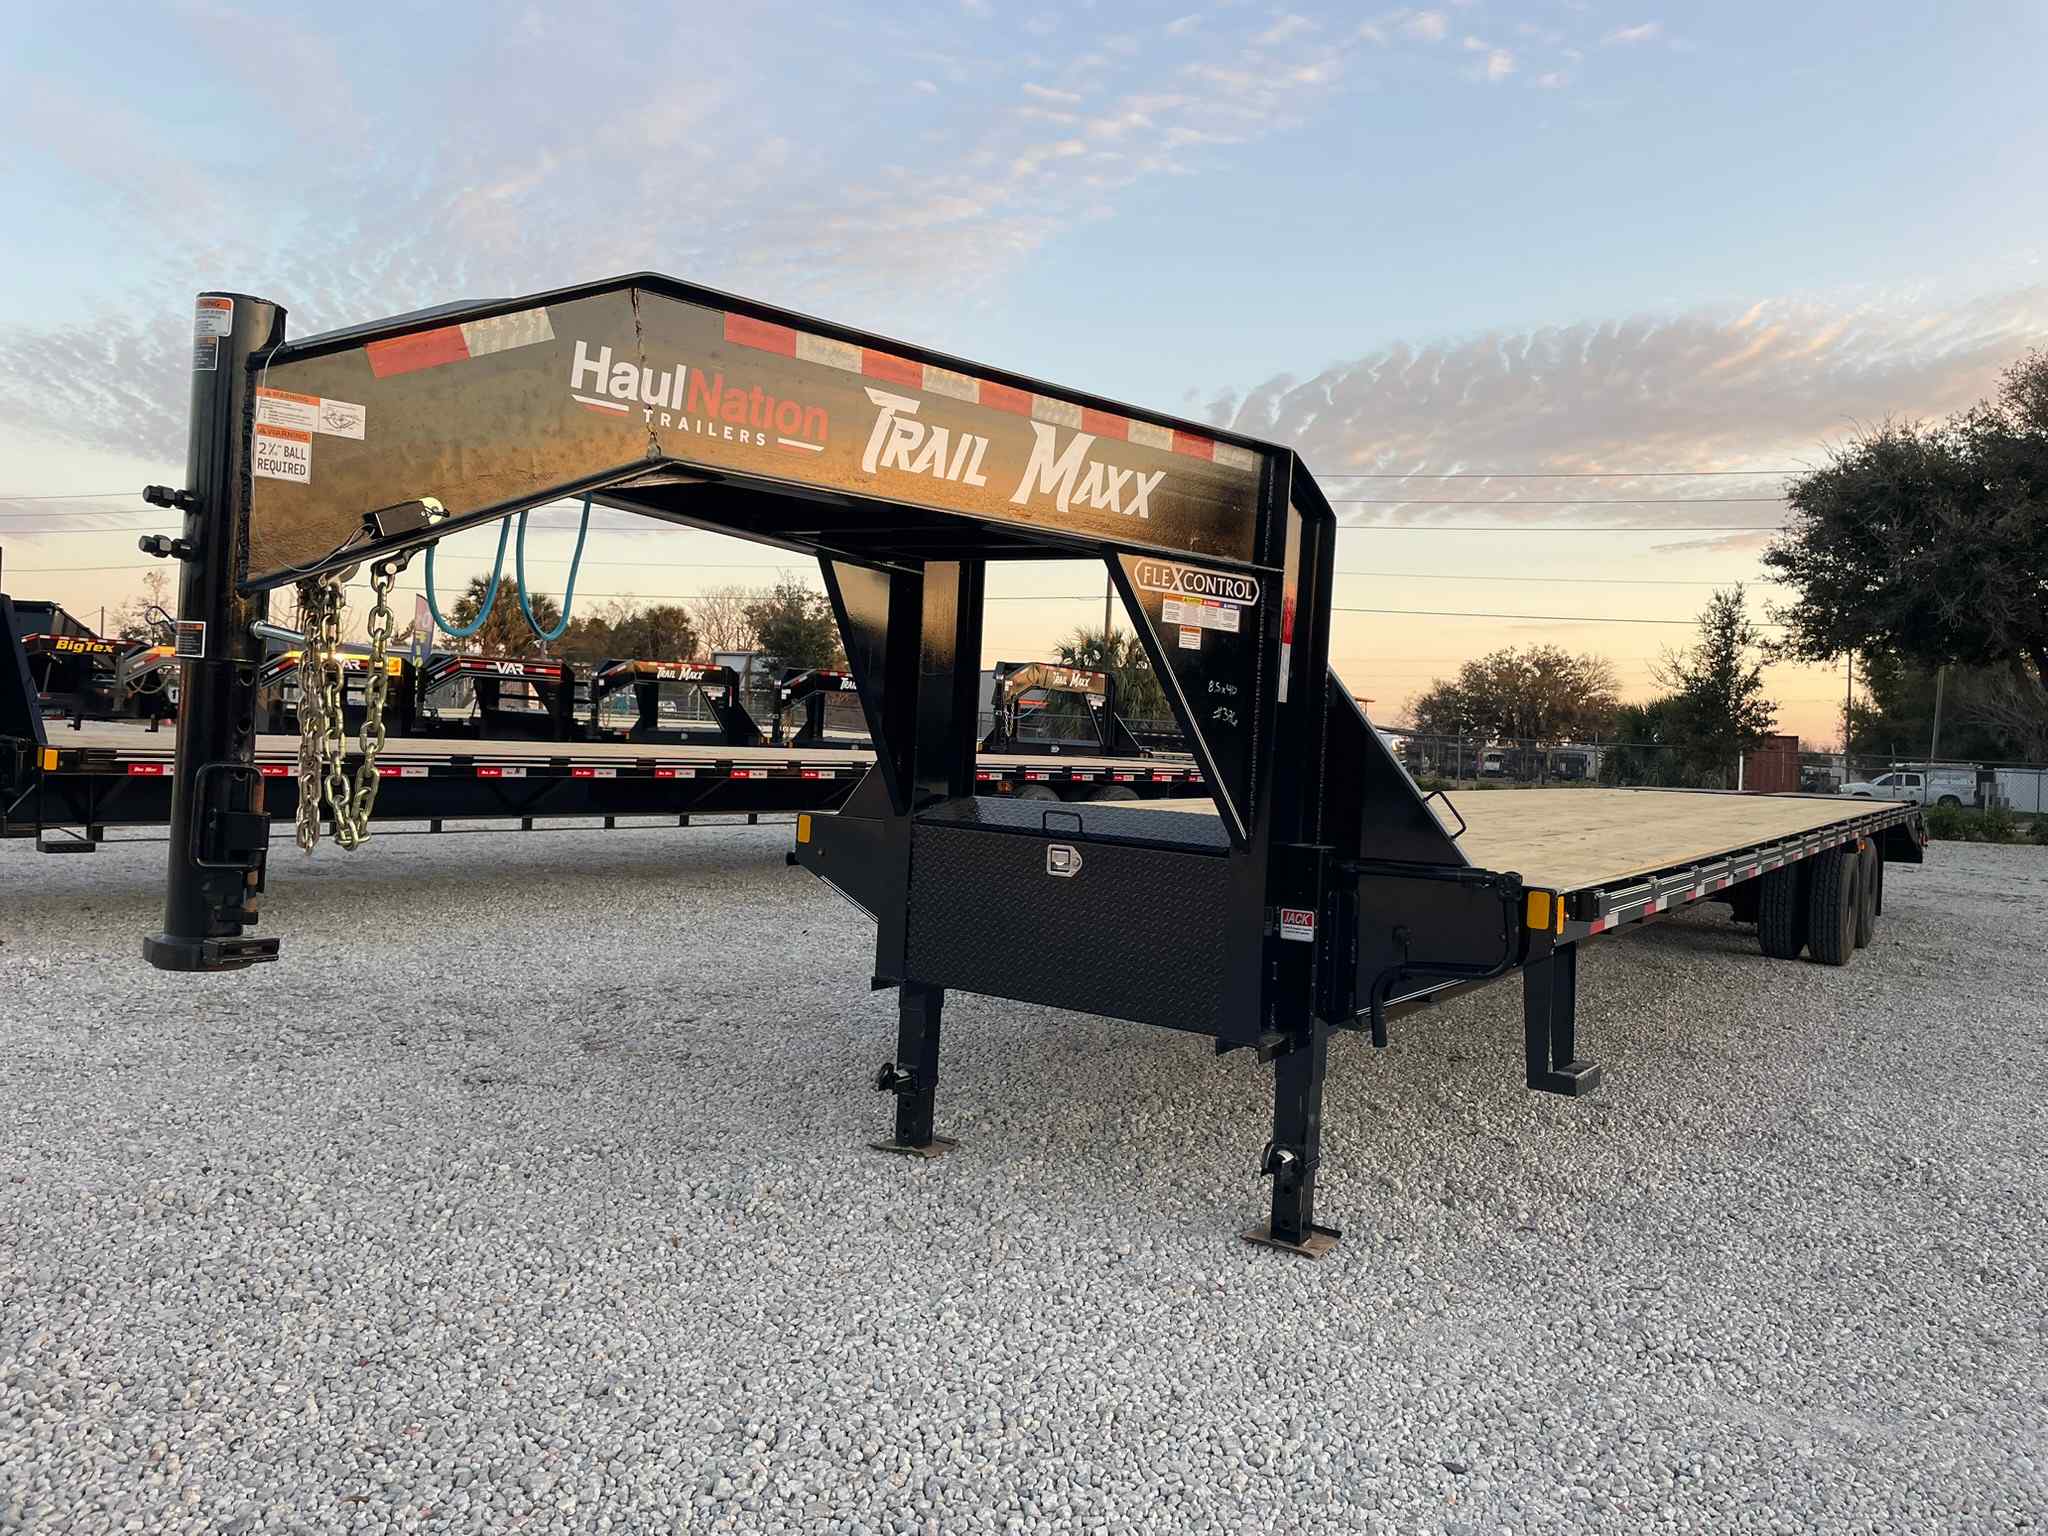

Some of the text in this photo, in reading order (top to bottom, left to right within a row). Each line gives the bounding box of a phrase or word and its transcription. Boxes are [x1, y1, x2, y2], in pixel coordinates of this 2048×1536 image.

[570, 340, 829, 442] HaulNation
[643, 408, 767, 446] TRAILERS
[284, 446, 306, 460] BALL
[861, 386, 1167, 519] TRAIL MAXX
[257, 458, 306, 476] REQUIRED
[496, 661, 525, 675] VAR
[657, 666, 705, 681] TRAIL MAXX
[1284, 912, 1309, 925] JACK
